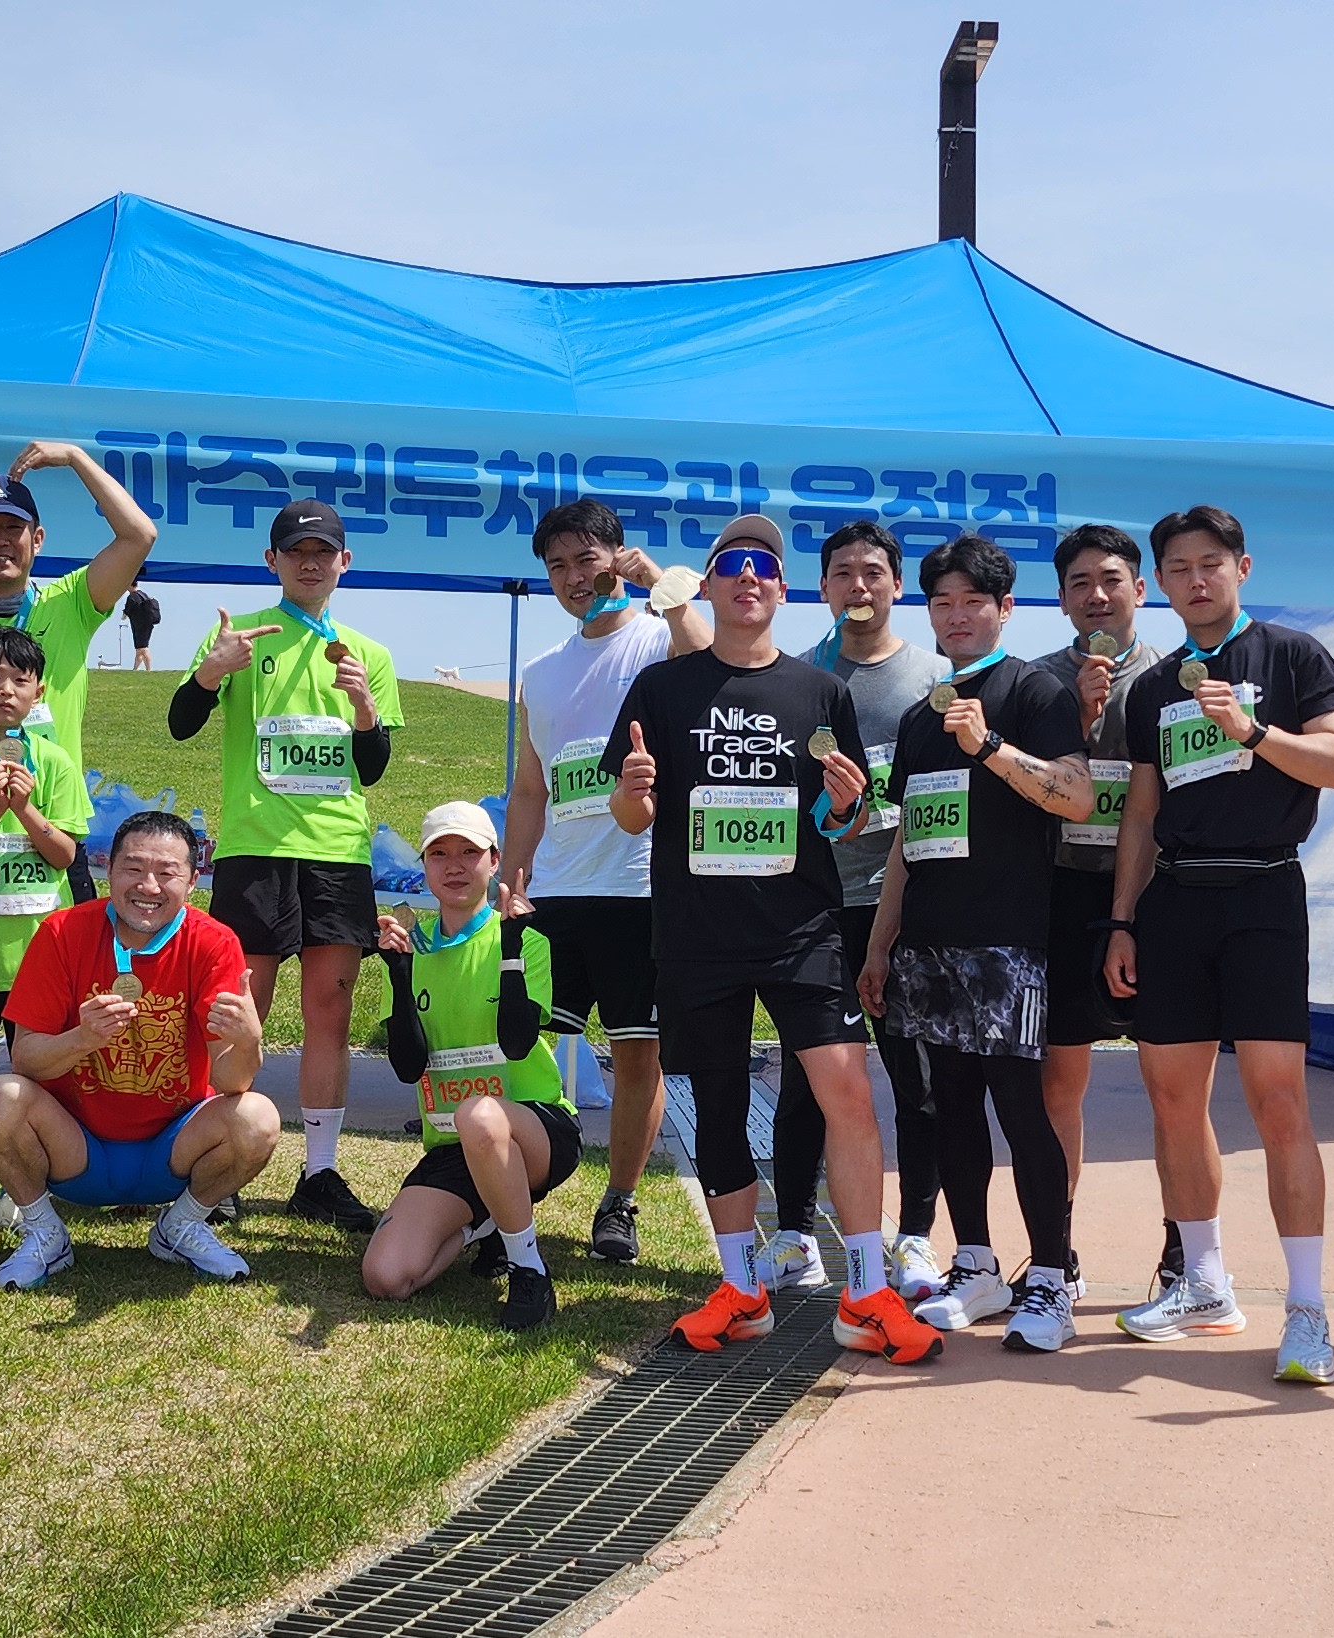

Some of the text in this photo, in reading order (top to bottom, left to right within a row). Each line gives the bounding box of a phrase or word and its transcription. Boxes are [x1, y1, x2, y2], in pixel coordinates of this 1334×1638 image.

[94, 430, 1057, 563] 파주권투체육관 운정점
[710, 706, 777, 732] Nike
[278, 744, 346, 767] 10455
[689, 728, 795, 757] Track
[566, 767, 618, 791] 1120
[707, 754, 777, 779] Club
[910, 803, 960, 830] 10345
[714, 819, 786, 843] 10841
[431, 1060, 447, 1068] 2024
[438, 1075, 505, 1103] 15293
[745, 1244, 758, 1286] RUNNING
[850, 1249, 862, 1290] RUNNING
[1162, 1300, 1224, 1318] new balance
